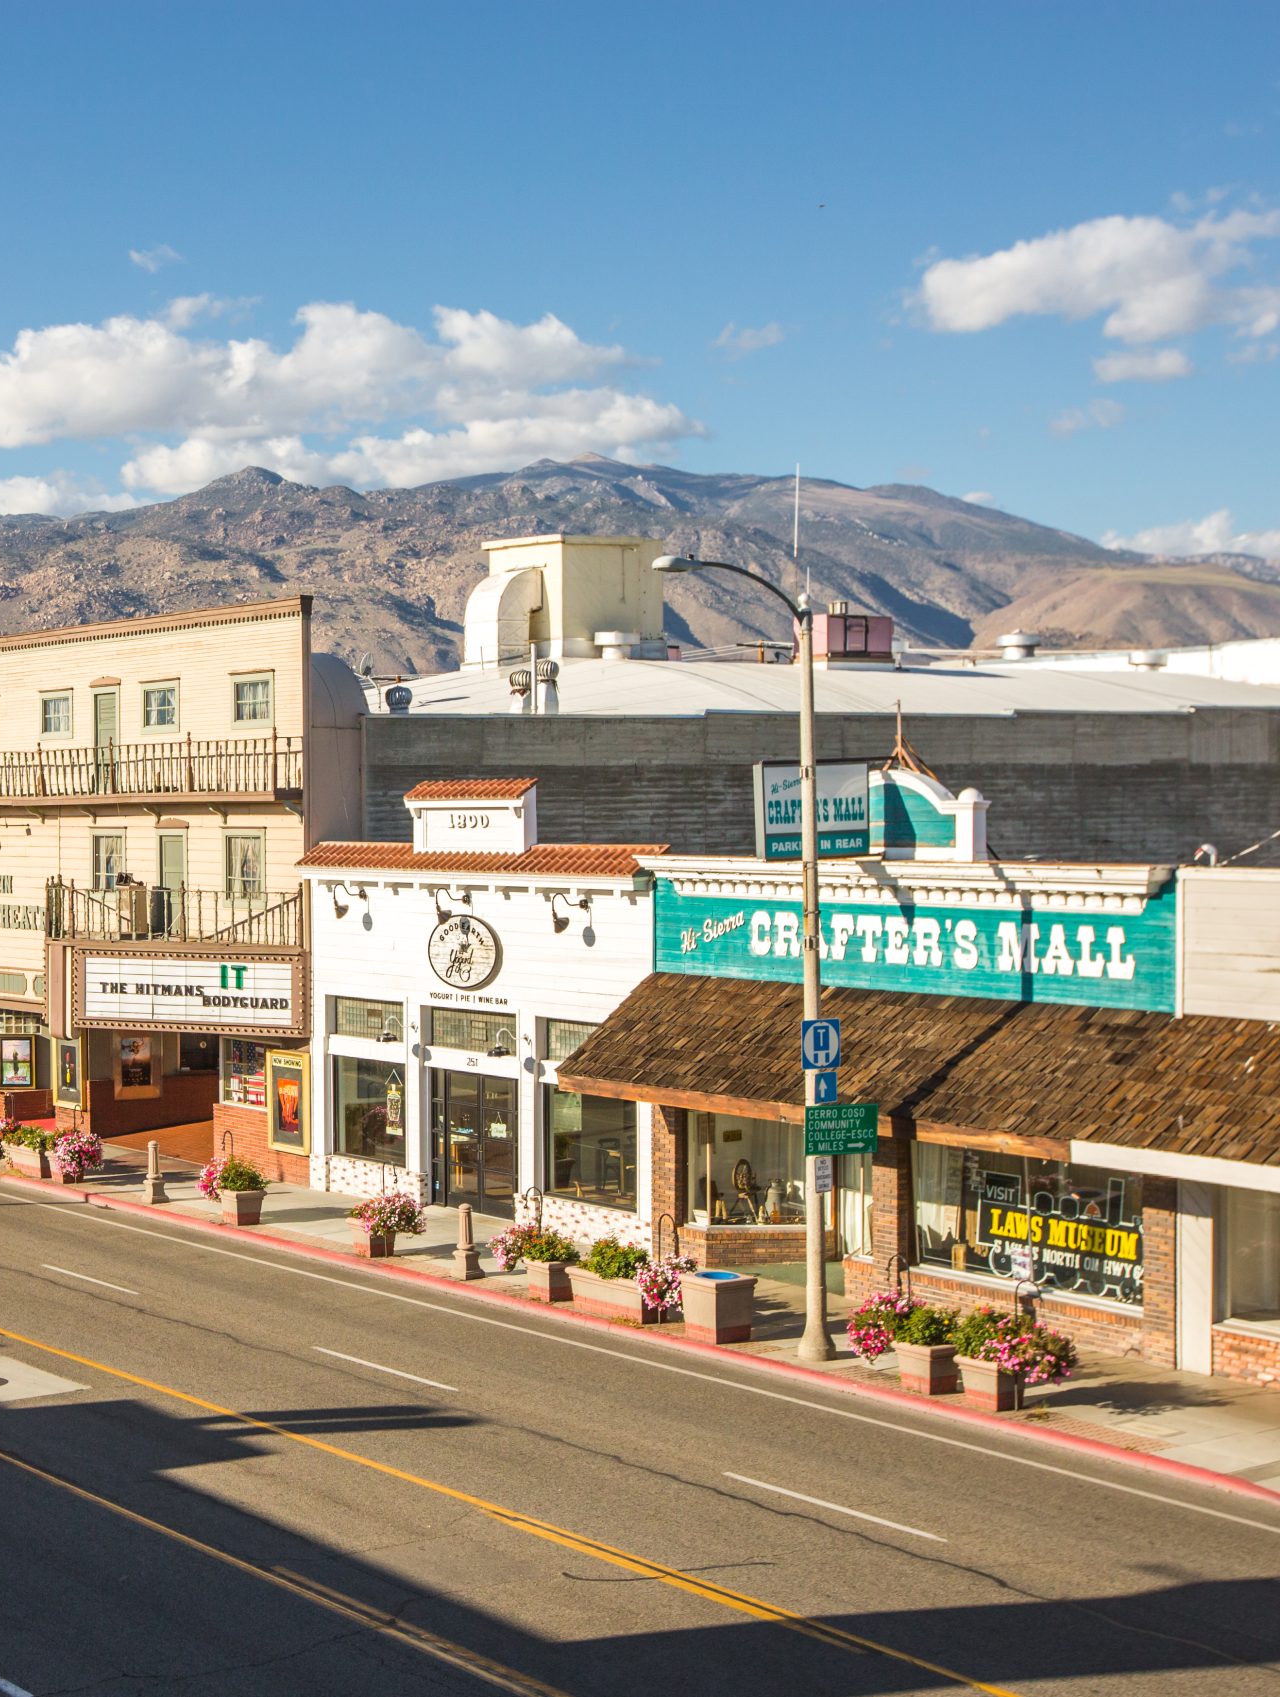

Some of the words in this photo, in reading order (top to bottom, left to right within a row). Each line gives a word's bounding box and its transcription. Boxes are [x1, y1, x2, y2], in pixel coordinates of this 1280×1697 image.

[767, 798, 829, 825] CRAFTR'S
[832, 797, 865, 822] MALL
[448, 813, 490, 829] 1890
[771, 842, 802, 852] PARKI
[821, 840, 831, 849] IN
[836, 838, 862, 848] REAR
[439, 922, 459, 942] GOOD
[461, 923, 485, 945] EARTH
[680, 911, 745, 954] Hi-Sierra
[996, 921, 1136, 980] MALL
[220, 964, 248, 990] IT
[100, 982, 128, 994] THE
[135, 983, 205, 997] HITMANS
[202, 996, 289, 1010] BODYGUARD
[429, 992, 452, 1001] YOGURT
[460, 995, 470, 1003] PIE
[478, 996, 494, 1005] WINE
[495, 997, 508, 1006] BAR
[283, 1059, 302, 1067] SHOWING
[808, 1109, 838, 1119] CERRO
[841, 1108, 865, 1118] COSO
[808, 1119, 861, 1130] COMMUNITY
[808, 1129, 874, 1141] COLLEGE-ESCC
[808, 1143, 814, 1152] 5
[818, 1141, 844, 1151] MILES
[986, 1184, 1016, 1202] VISIT
[989, 1208, 1043, 1243] LAWS
[1047, 1218, 1139, 1260] MUSEUM
[993, 1239, 1002, 1254] 5
[1042, 1248, 1080, 1269] NORTH
[1083, 1257, 1099, 1272] ON
[1103, 1259, 1131, 1278] HWY
